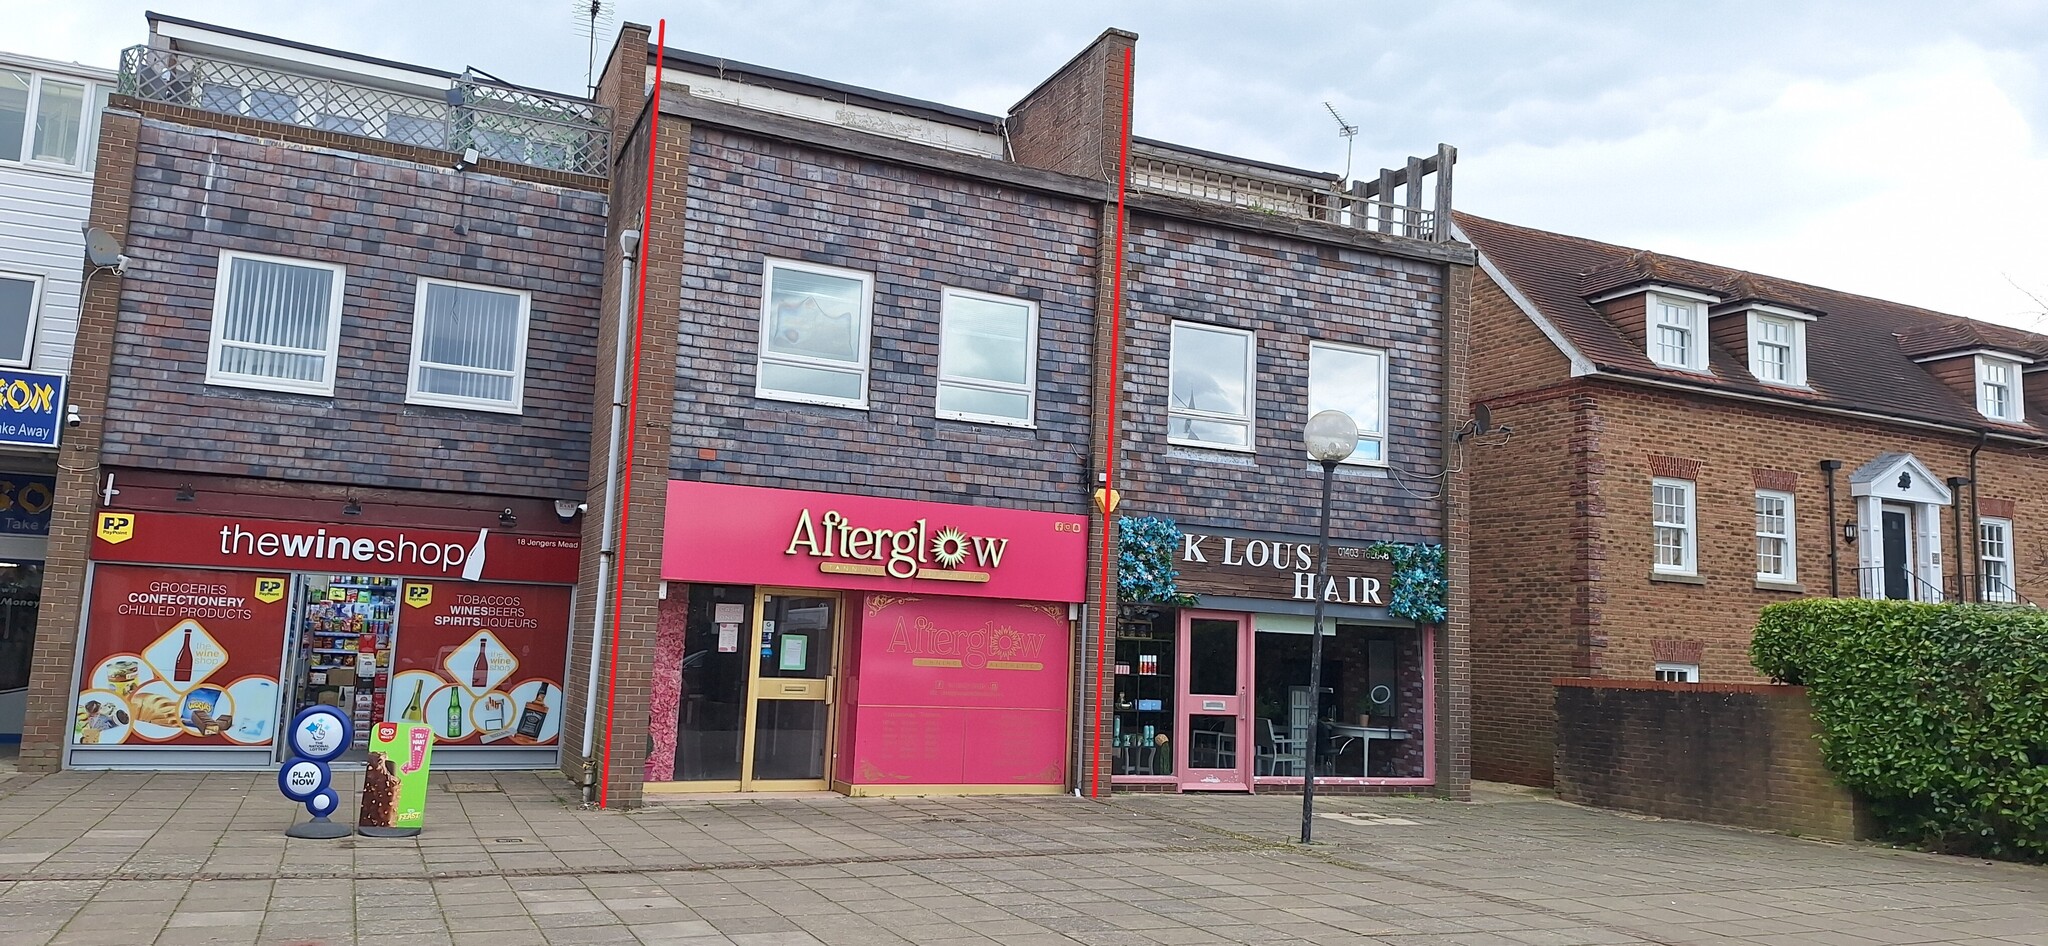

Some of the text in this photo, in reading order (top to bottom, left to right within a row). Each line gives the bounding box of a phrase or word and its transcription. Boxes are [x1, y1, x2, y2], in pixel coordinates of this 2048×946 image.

[18, 423, 49, 440] Away
[6, 518, 39, 530] Take
[527, 539, 557, 548] Jengers
[557, 540, 579, 549] Mead
[786, 508, 1009, 579] Afterglow
[1181, 533, 1312, 571] K LOUS
[149, 581, 227, 595] GROCERIES
[1292, 571, 1383, 605] HAIR
[128, 592, 246, 608] CONFECTIONERY
[456, 594, 520, 606] TOBACCOS
[118, 604, 252, 620] CHILLED PRODUCTS
[887, 615, 1047, 669] Afterglow
[195, 657, 219, 666] shop
[292, 771, 316, 779] PLAY
[292, 778, 315, 786] NOW
